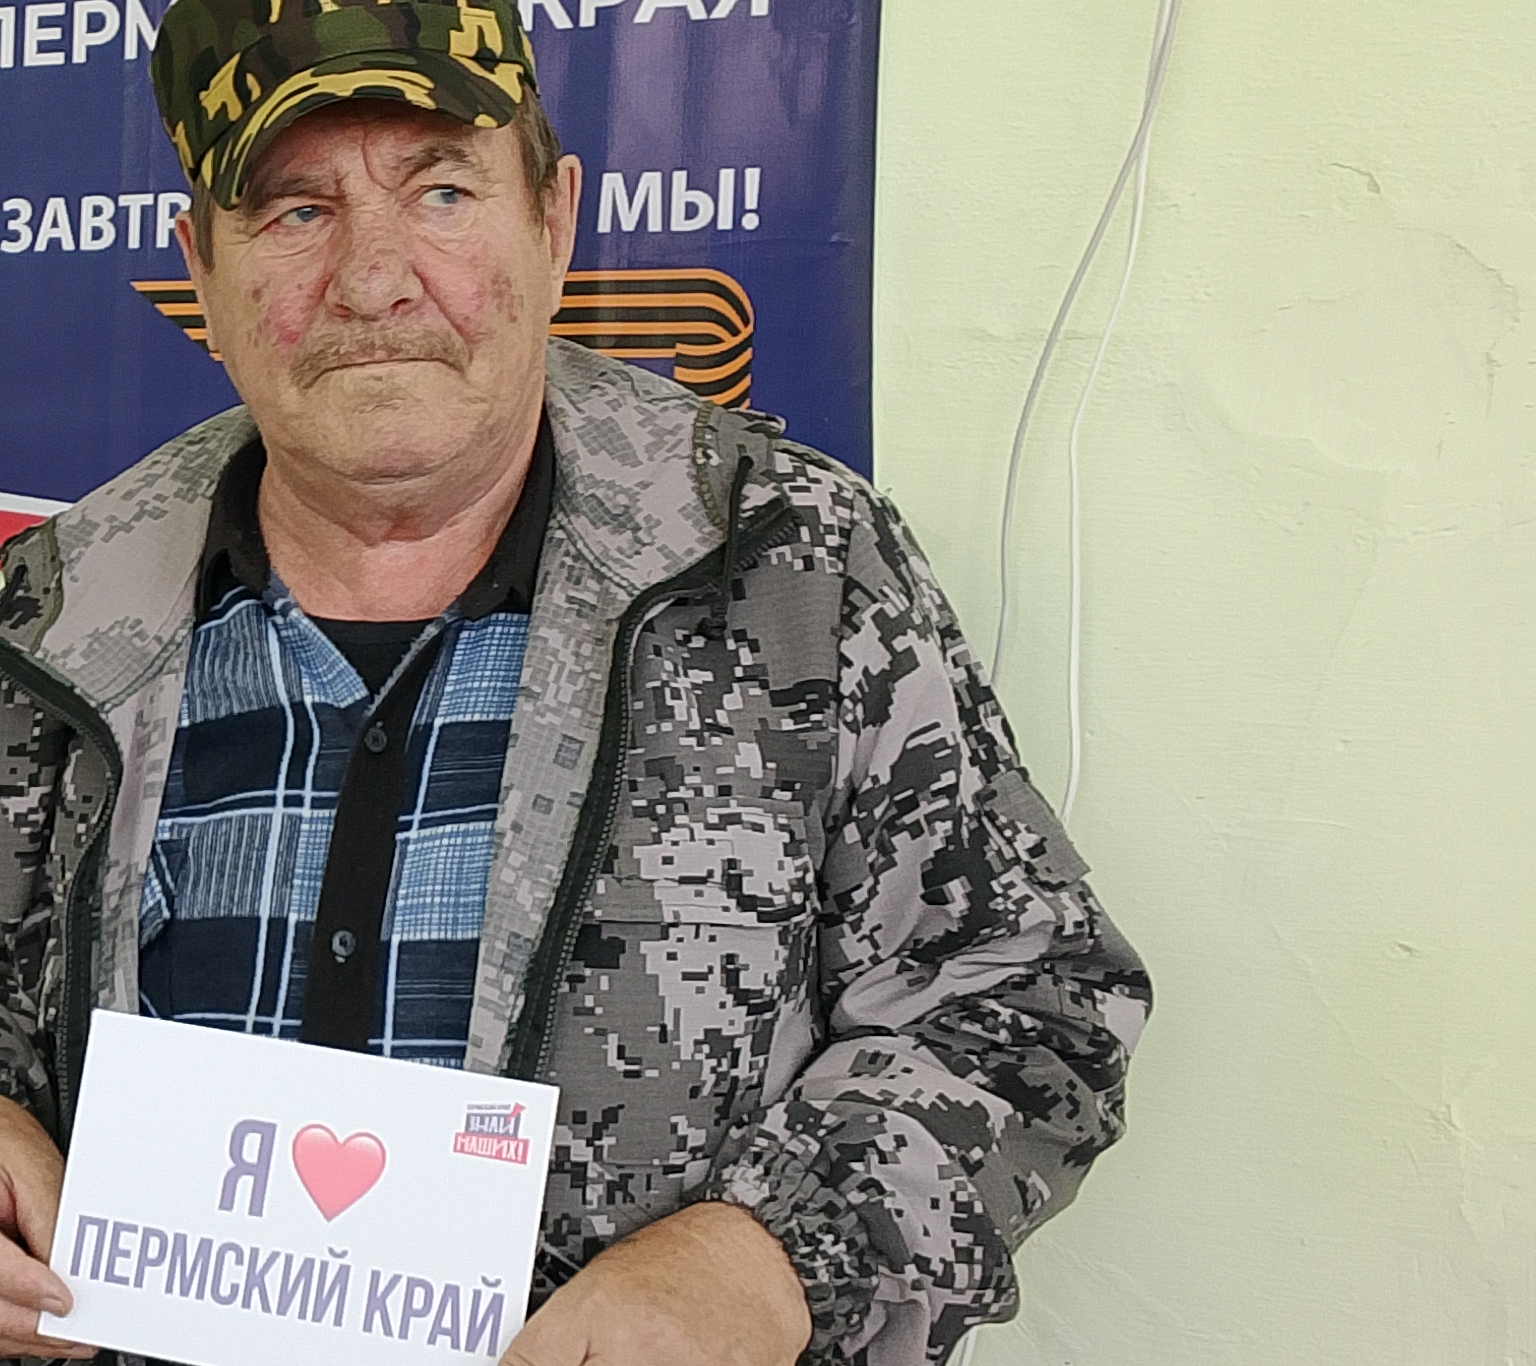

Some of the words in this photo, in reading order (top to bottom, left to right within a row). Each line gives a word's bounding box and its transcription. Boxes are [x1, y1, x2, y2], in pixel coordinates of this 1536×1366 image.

[597, 167, 761, 234] МЫ!
[217, 1119, 277, 1218] Я
[69, 1215, 352, 1327] ПЕРМСКИЙ
[362, 1269, 506, 1357] КРАЙ
